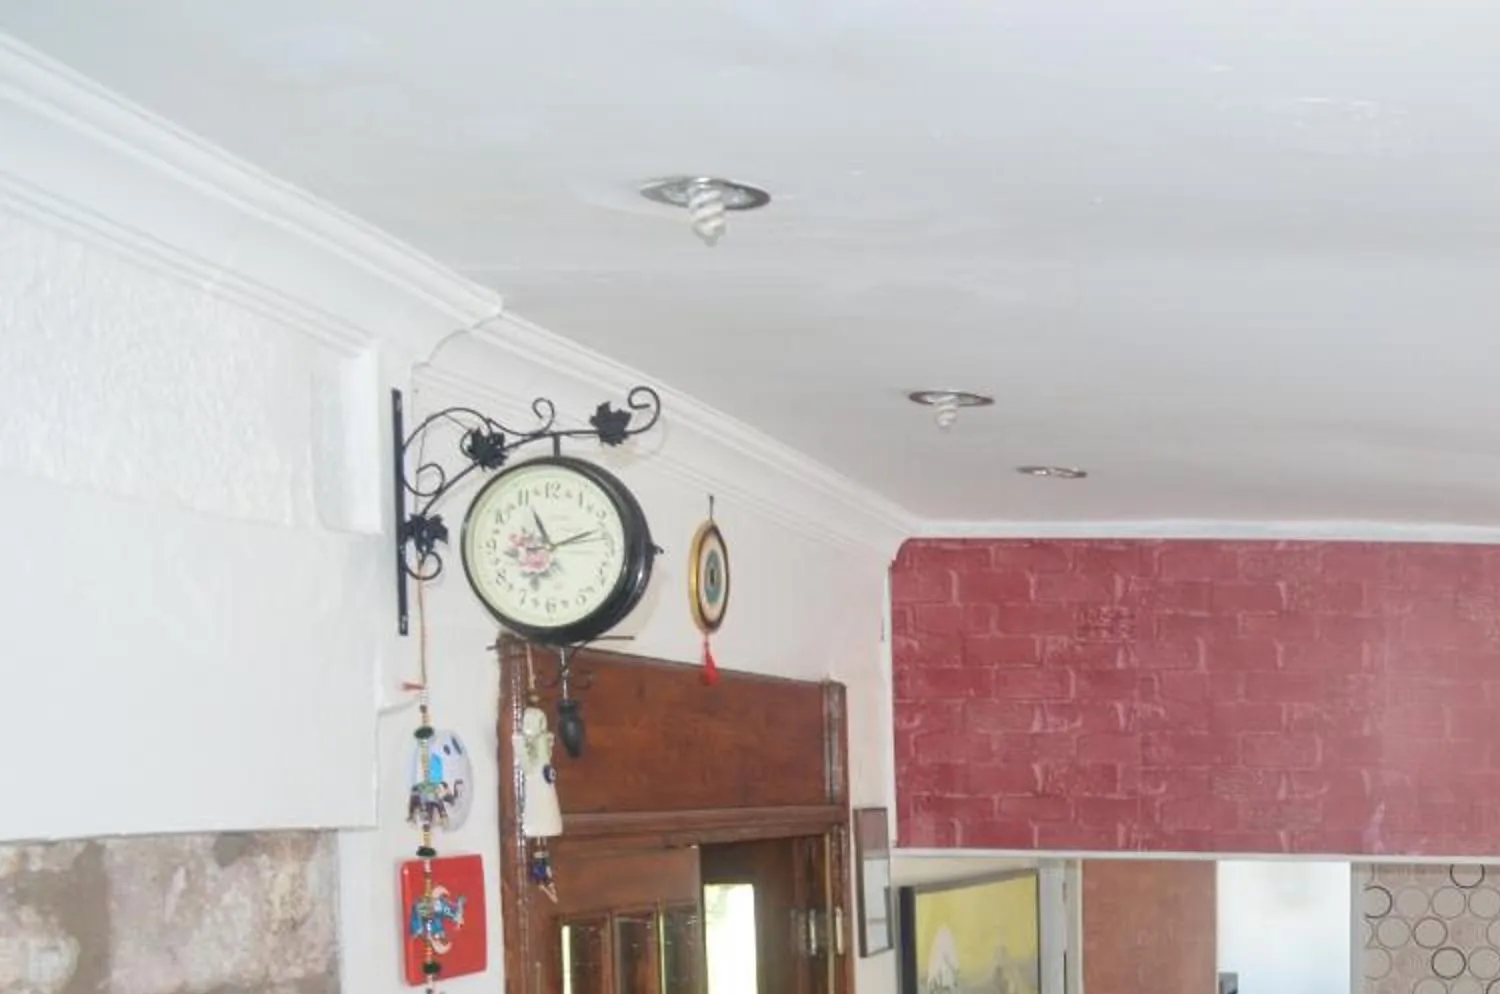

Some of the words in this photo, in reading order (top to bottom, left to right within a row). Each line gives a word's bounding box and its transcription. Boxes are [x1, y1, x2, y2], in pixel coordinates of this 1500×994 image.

[517, 487, 530, 507] 11
[544, 480, 562, 500] 12
[577, 489, 584, 509] 1
[519, 588, 528, 608] 7
[544, 596, 558, 614] 6
